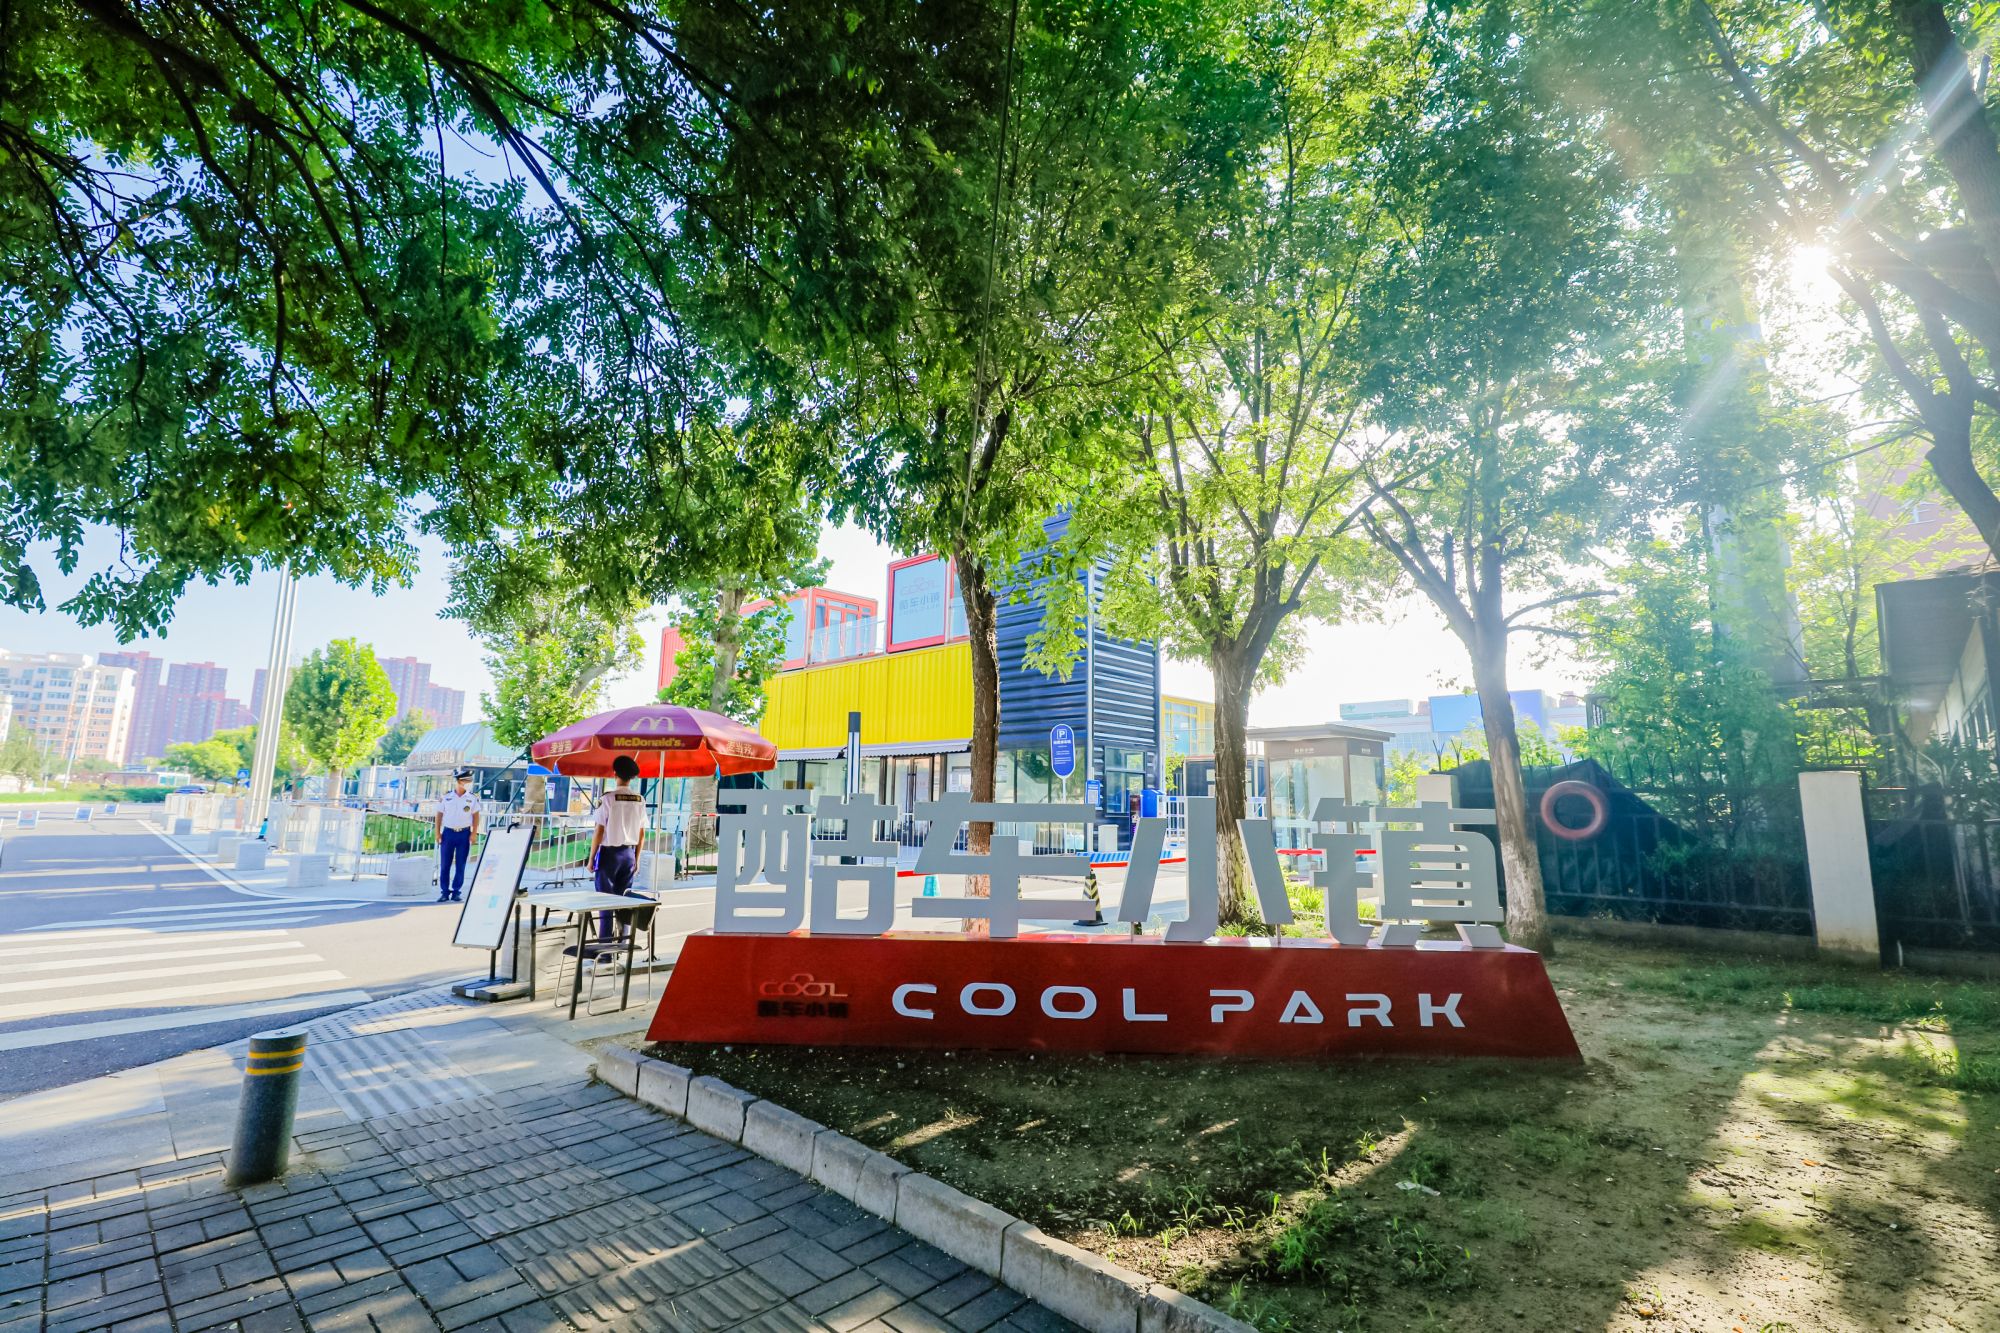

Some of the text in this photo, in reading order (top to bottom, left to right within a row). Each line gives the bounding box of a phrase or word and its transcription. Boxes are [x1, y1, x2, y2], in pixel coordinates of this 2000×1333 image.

[613, 737, 681, 747] McDonald's
[713, 787, 1506, 949] 酷车小镇
[891, 982, 1466, 1028] COOL PARK
